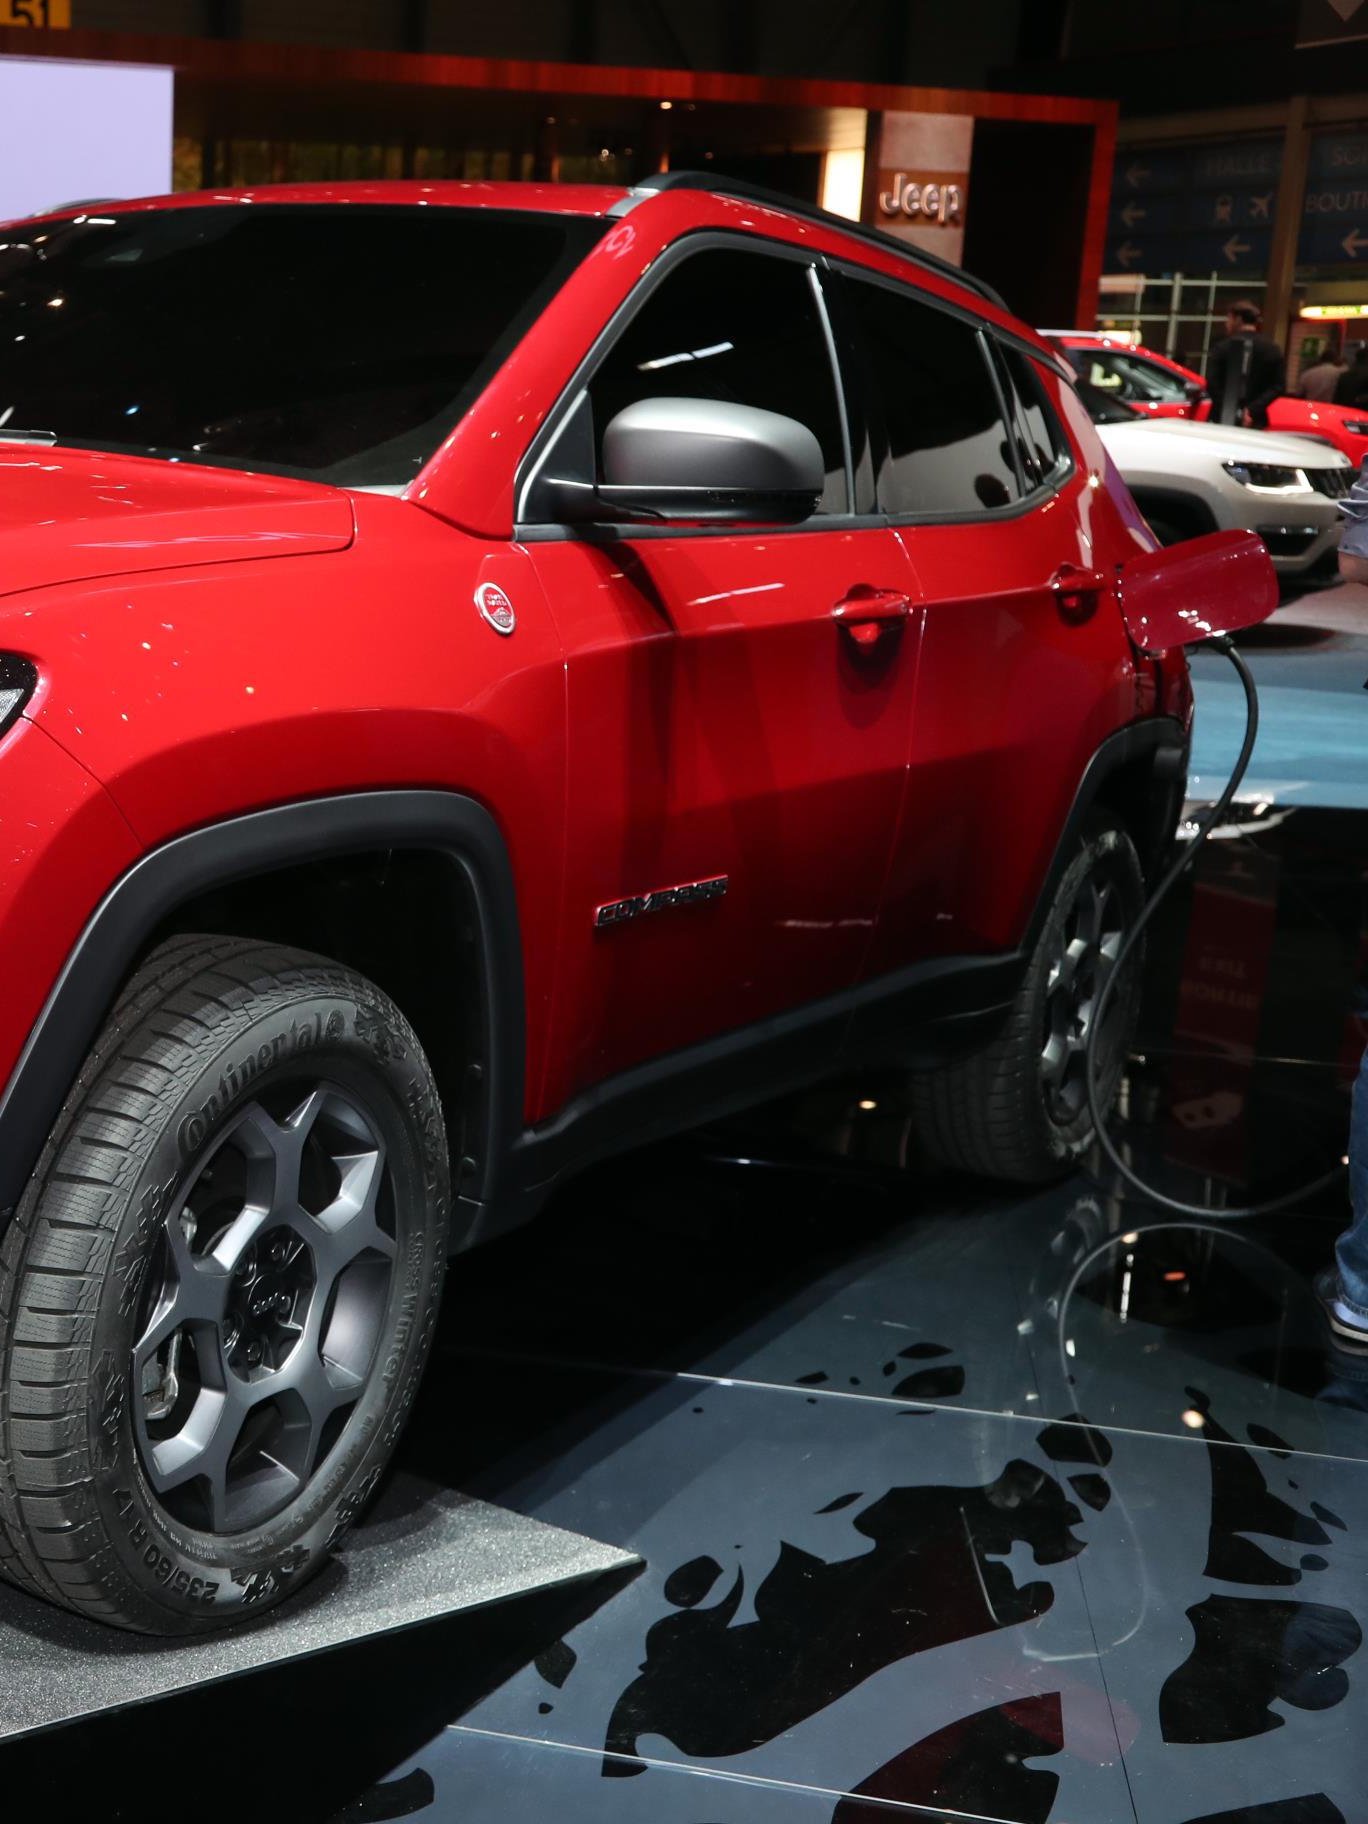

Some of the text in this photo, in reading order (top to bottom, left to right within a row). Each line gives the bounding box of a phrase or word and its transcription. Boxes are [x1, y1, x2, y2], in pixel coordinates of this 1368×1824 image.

[879, 172, 963, 223] Jeep
[1305, 190, 1368, 214] BOUTI
[178, 1011, 324, 1160] Continental
[143, 1543, 220, 1604] 235/60
